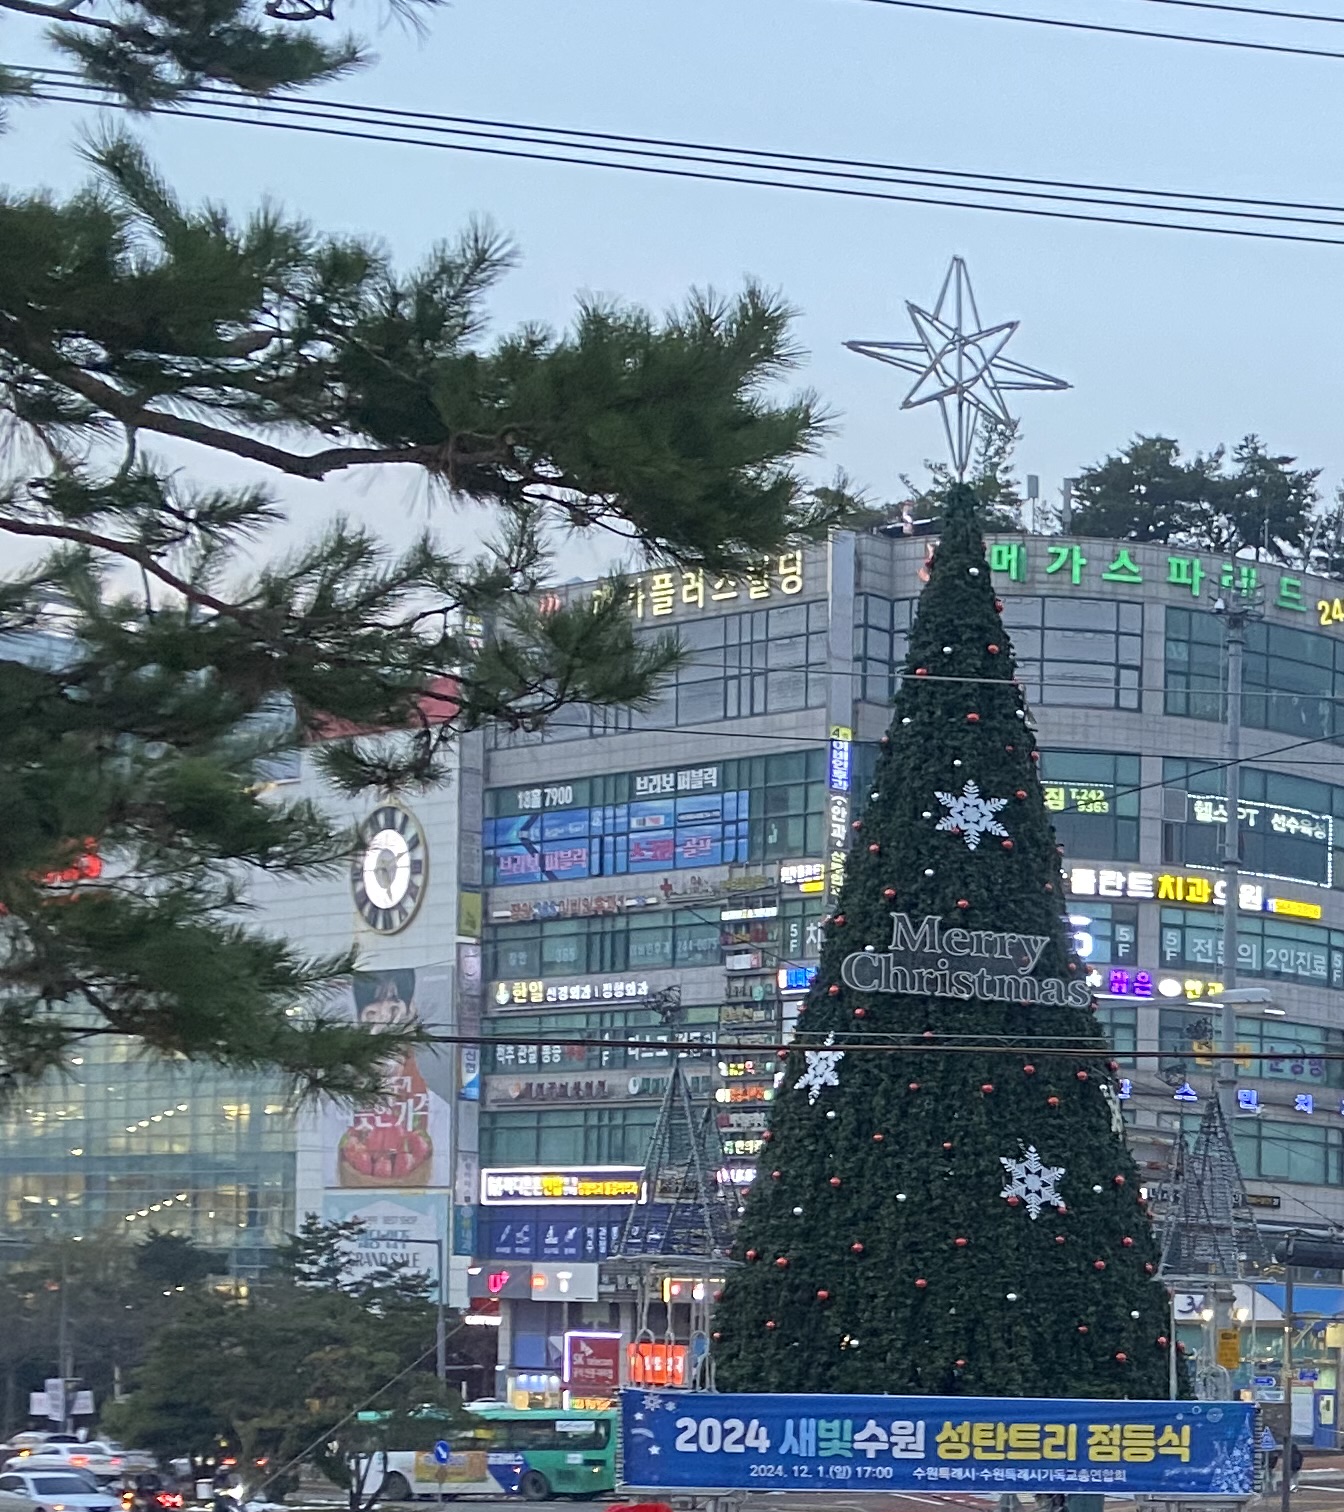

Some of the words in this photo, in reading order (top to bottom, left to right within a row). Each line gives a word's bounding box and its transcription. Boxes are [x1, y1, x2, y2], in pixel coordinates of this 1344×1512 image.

[888, 912, 1051, 975] Merry
[1115, 926, 1131, 957] 5F
[1163, 932, 1178, 961] 5F
[1265, 948, 1328, 978] 2인진료
[1330, 953, 1342, 983] 5F
[512, 980, 545, 1004] 한일
[546, 984, 592, 1002] 신경외과
[602, 981, 649, 999] 정형외과
[841, 951, 1093, 1009] Christmas
[675, 1417, 771, 1453] 2024
[778, 1418, 926, 1459] 새빛수원
[935, 1421, 1077, 1461] 성탄트리
[1087, 1424, 1192, 1463] 점등식
[750, 1465, 785, 1478] 2024.
[792, 1465, 813, 1478] 12.
[855, 1465, 894, 1479] 17:00
